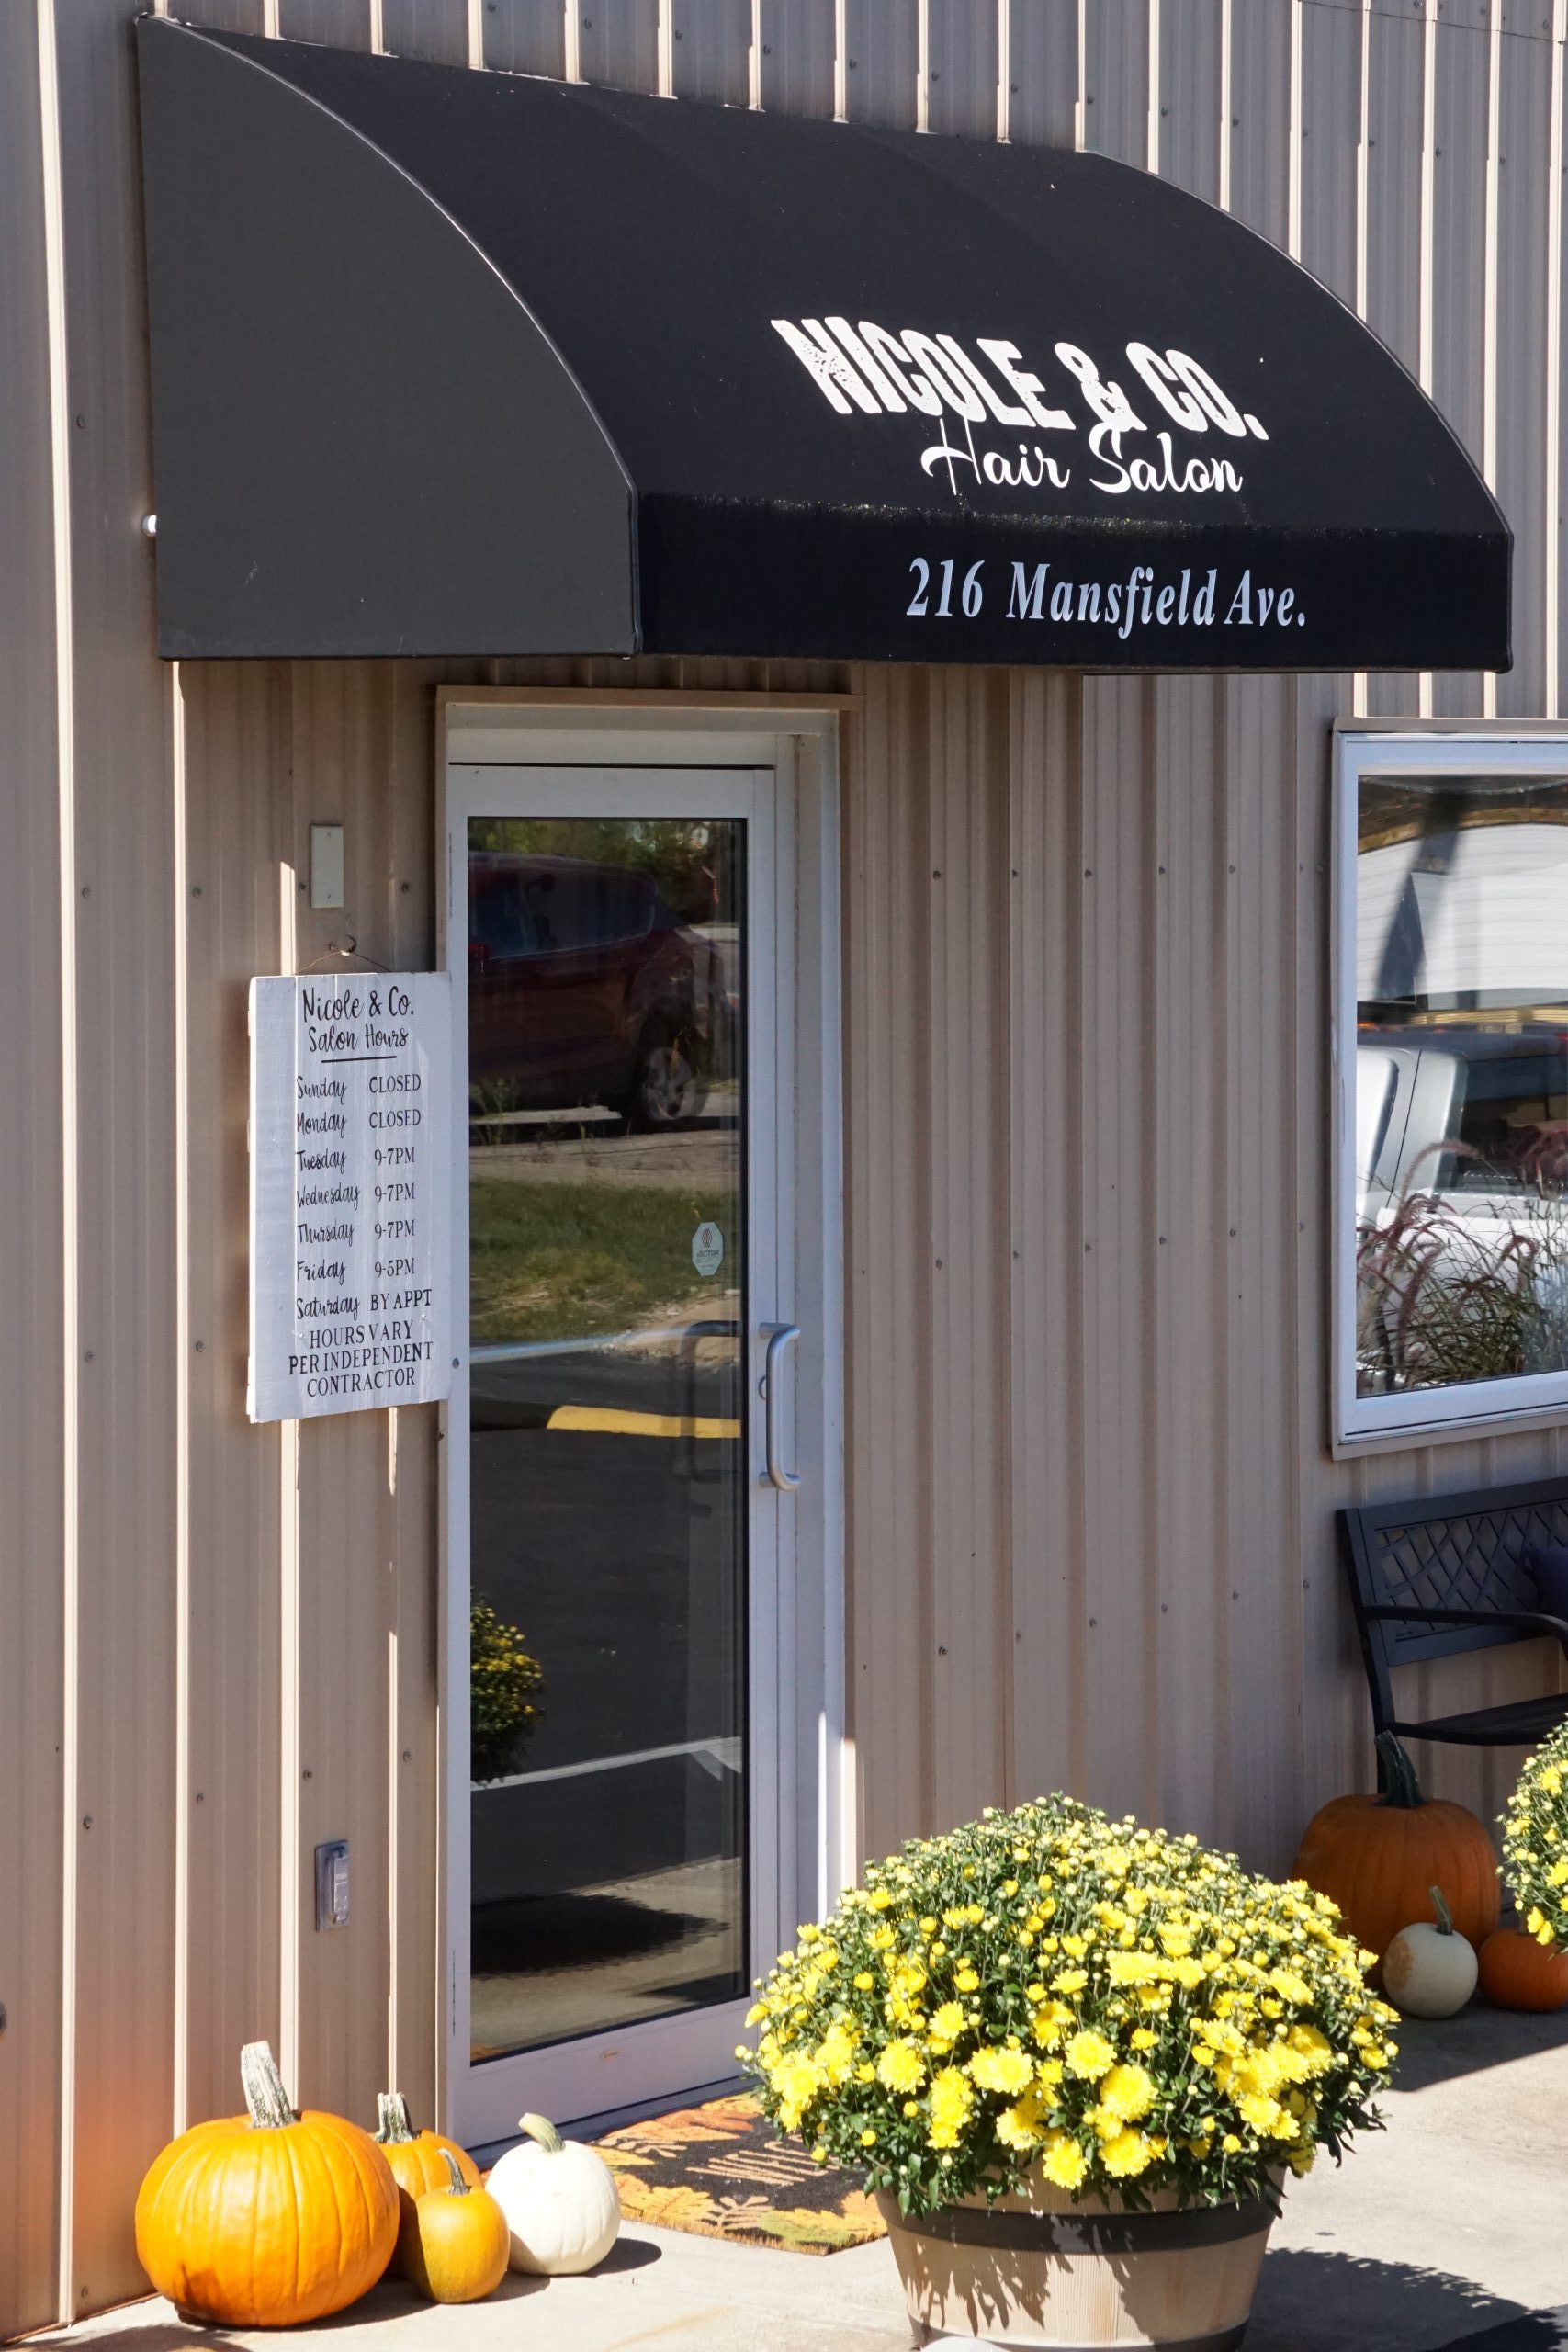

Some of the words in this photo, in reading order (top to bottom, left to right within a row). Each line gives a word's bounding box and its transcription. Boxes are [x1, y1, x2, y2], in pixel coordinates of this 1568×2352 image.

[771, 316, 1076, 430] NICOLE
[1055, 342, 1147, 432] &
[1126, 342, 1269, 440] CO.
[920, 417, 1070, 495] Hair
[1089, 422, 1243, 494] Salon
[906, 557, 986, 617] 216
[1006, 560, 1218, 639] Mansfield
[1224, 569, 1306, 627] Ave.
[302, 987, 364, 1023] Nicole
[369, 990, 382, 1017] &
[389, 986, 414, 1016] Co.
[308, 1026, 359, 1052] Salon
[365, 1023, 409, 1049] Hours
[297, 1076, 347, 1105] Sunday
[369, 1074, 422, 1093] CLOSED
[297, 1113, 347, 1138] Monday
[369, 1109, 422, 1128] CLOSED
[296, 1148, 346, 1174] Tuesday
[374, 1147, 415, 1166] 9-7PM
[297, 1182, 360, 1210] Wednesday
[374, 1182, 415, 1203] 9-7PM
[297, 1218, 354, 1247] Thursday
[374, 1219, 415, 1239] 9-7PM
[297, 1259, 345, 1285] Friday
[374, 1258, 415, 1278] 9-5PM
[297, 1296, 359, 1320] Saturday
[370, 1293, 390, 1311] BY
[393, 1289, 432, 1309] APPT
[310, 1326, 365, 1349] HOURS
[369, 1319, 413, 1341] VARY
[288, 1355, 320, 1374] PER
[323, 1341, 433, 1371] INDEPENDENT
[307, 1367, 415, 1396] CONTRACTOR
